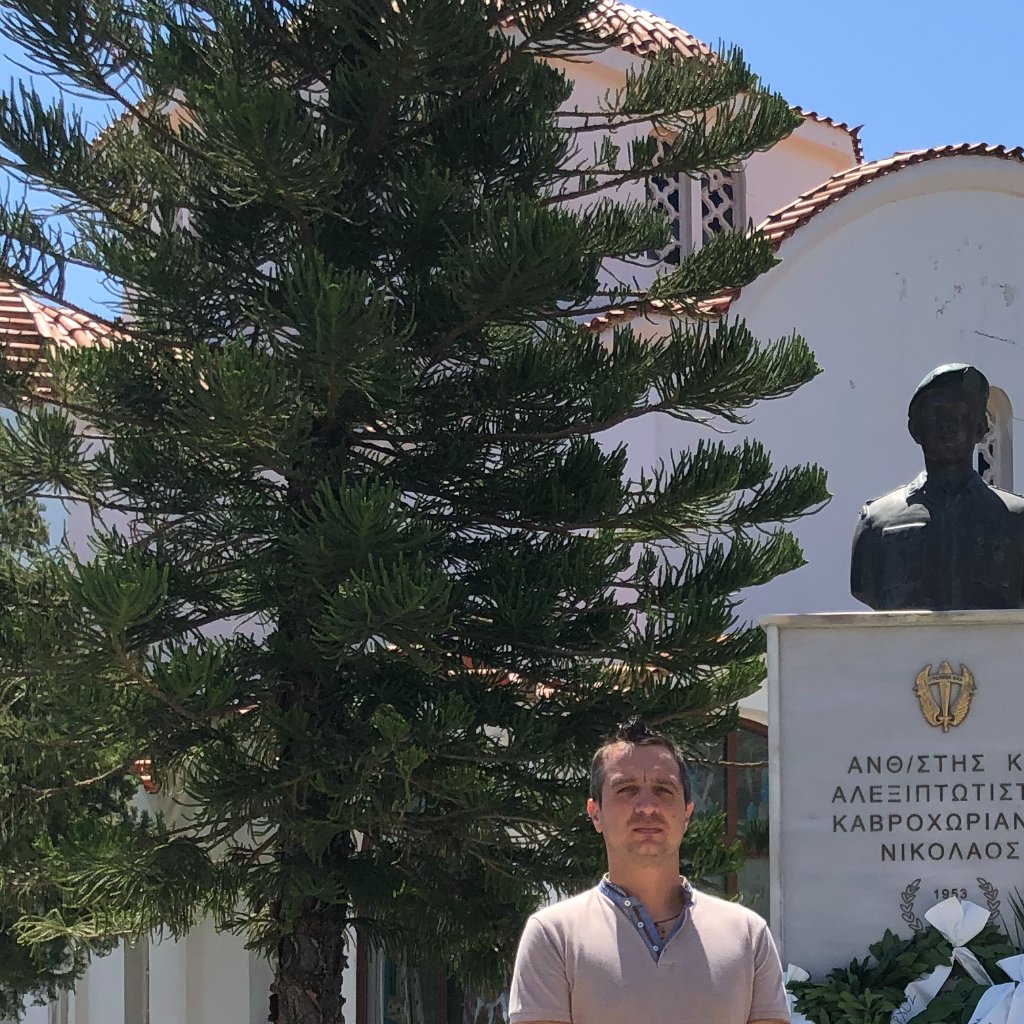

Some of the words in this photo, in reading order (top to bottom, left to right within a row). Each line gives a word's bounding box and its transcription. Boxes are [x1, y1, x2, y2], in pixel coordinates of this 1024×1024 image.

[847, 753, 985, 774] ΑΝΘ/ΣΤΗΣ
[880, 841, 1020, 862] ΝΙΚΟΛΑΟΣ
[933, 888, 968, 900] 1953
